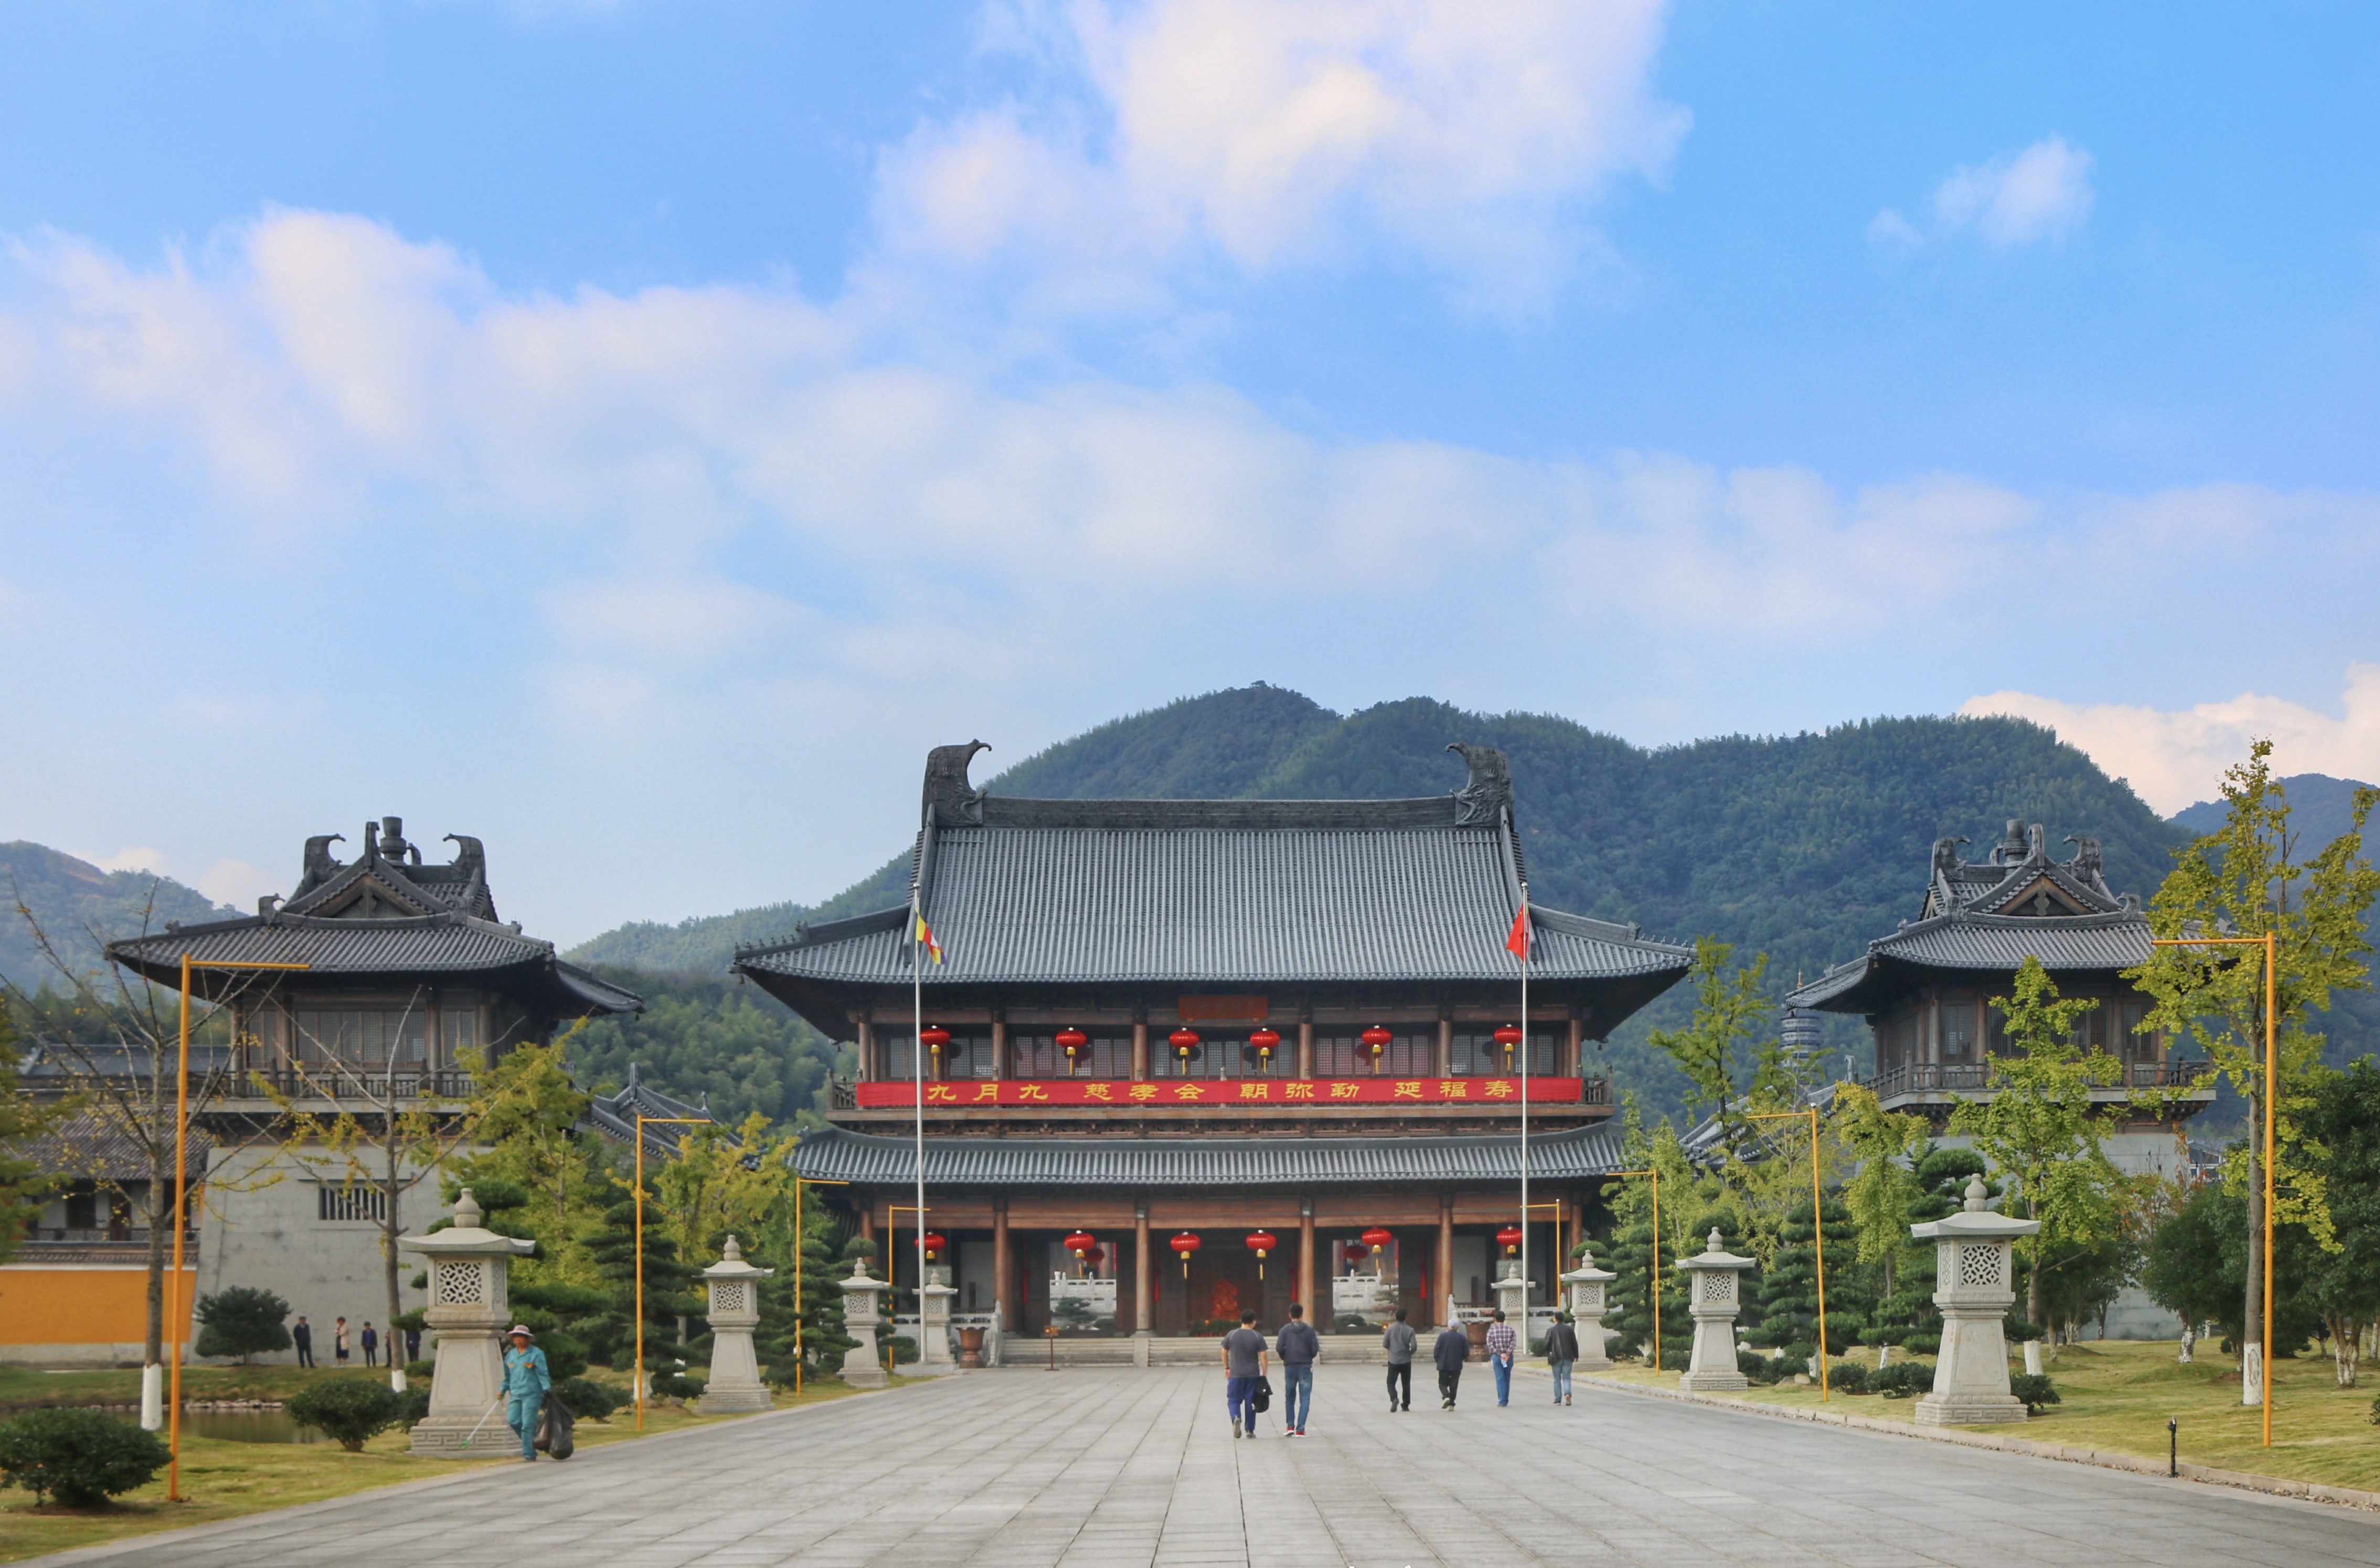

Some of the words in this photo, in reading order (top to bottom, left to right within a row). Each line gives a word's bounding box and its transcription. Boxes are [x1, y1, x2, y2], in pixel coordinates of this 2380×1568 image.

[927, 1083, 1048, 1101] 九月九
[1084, 1083, 1205, 1100] 慈孝会
[1239, 1082, 1360, 1099] 朝弥勒
[1394, 1080, 1514, 1098] 延福寿
